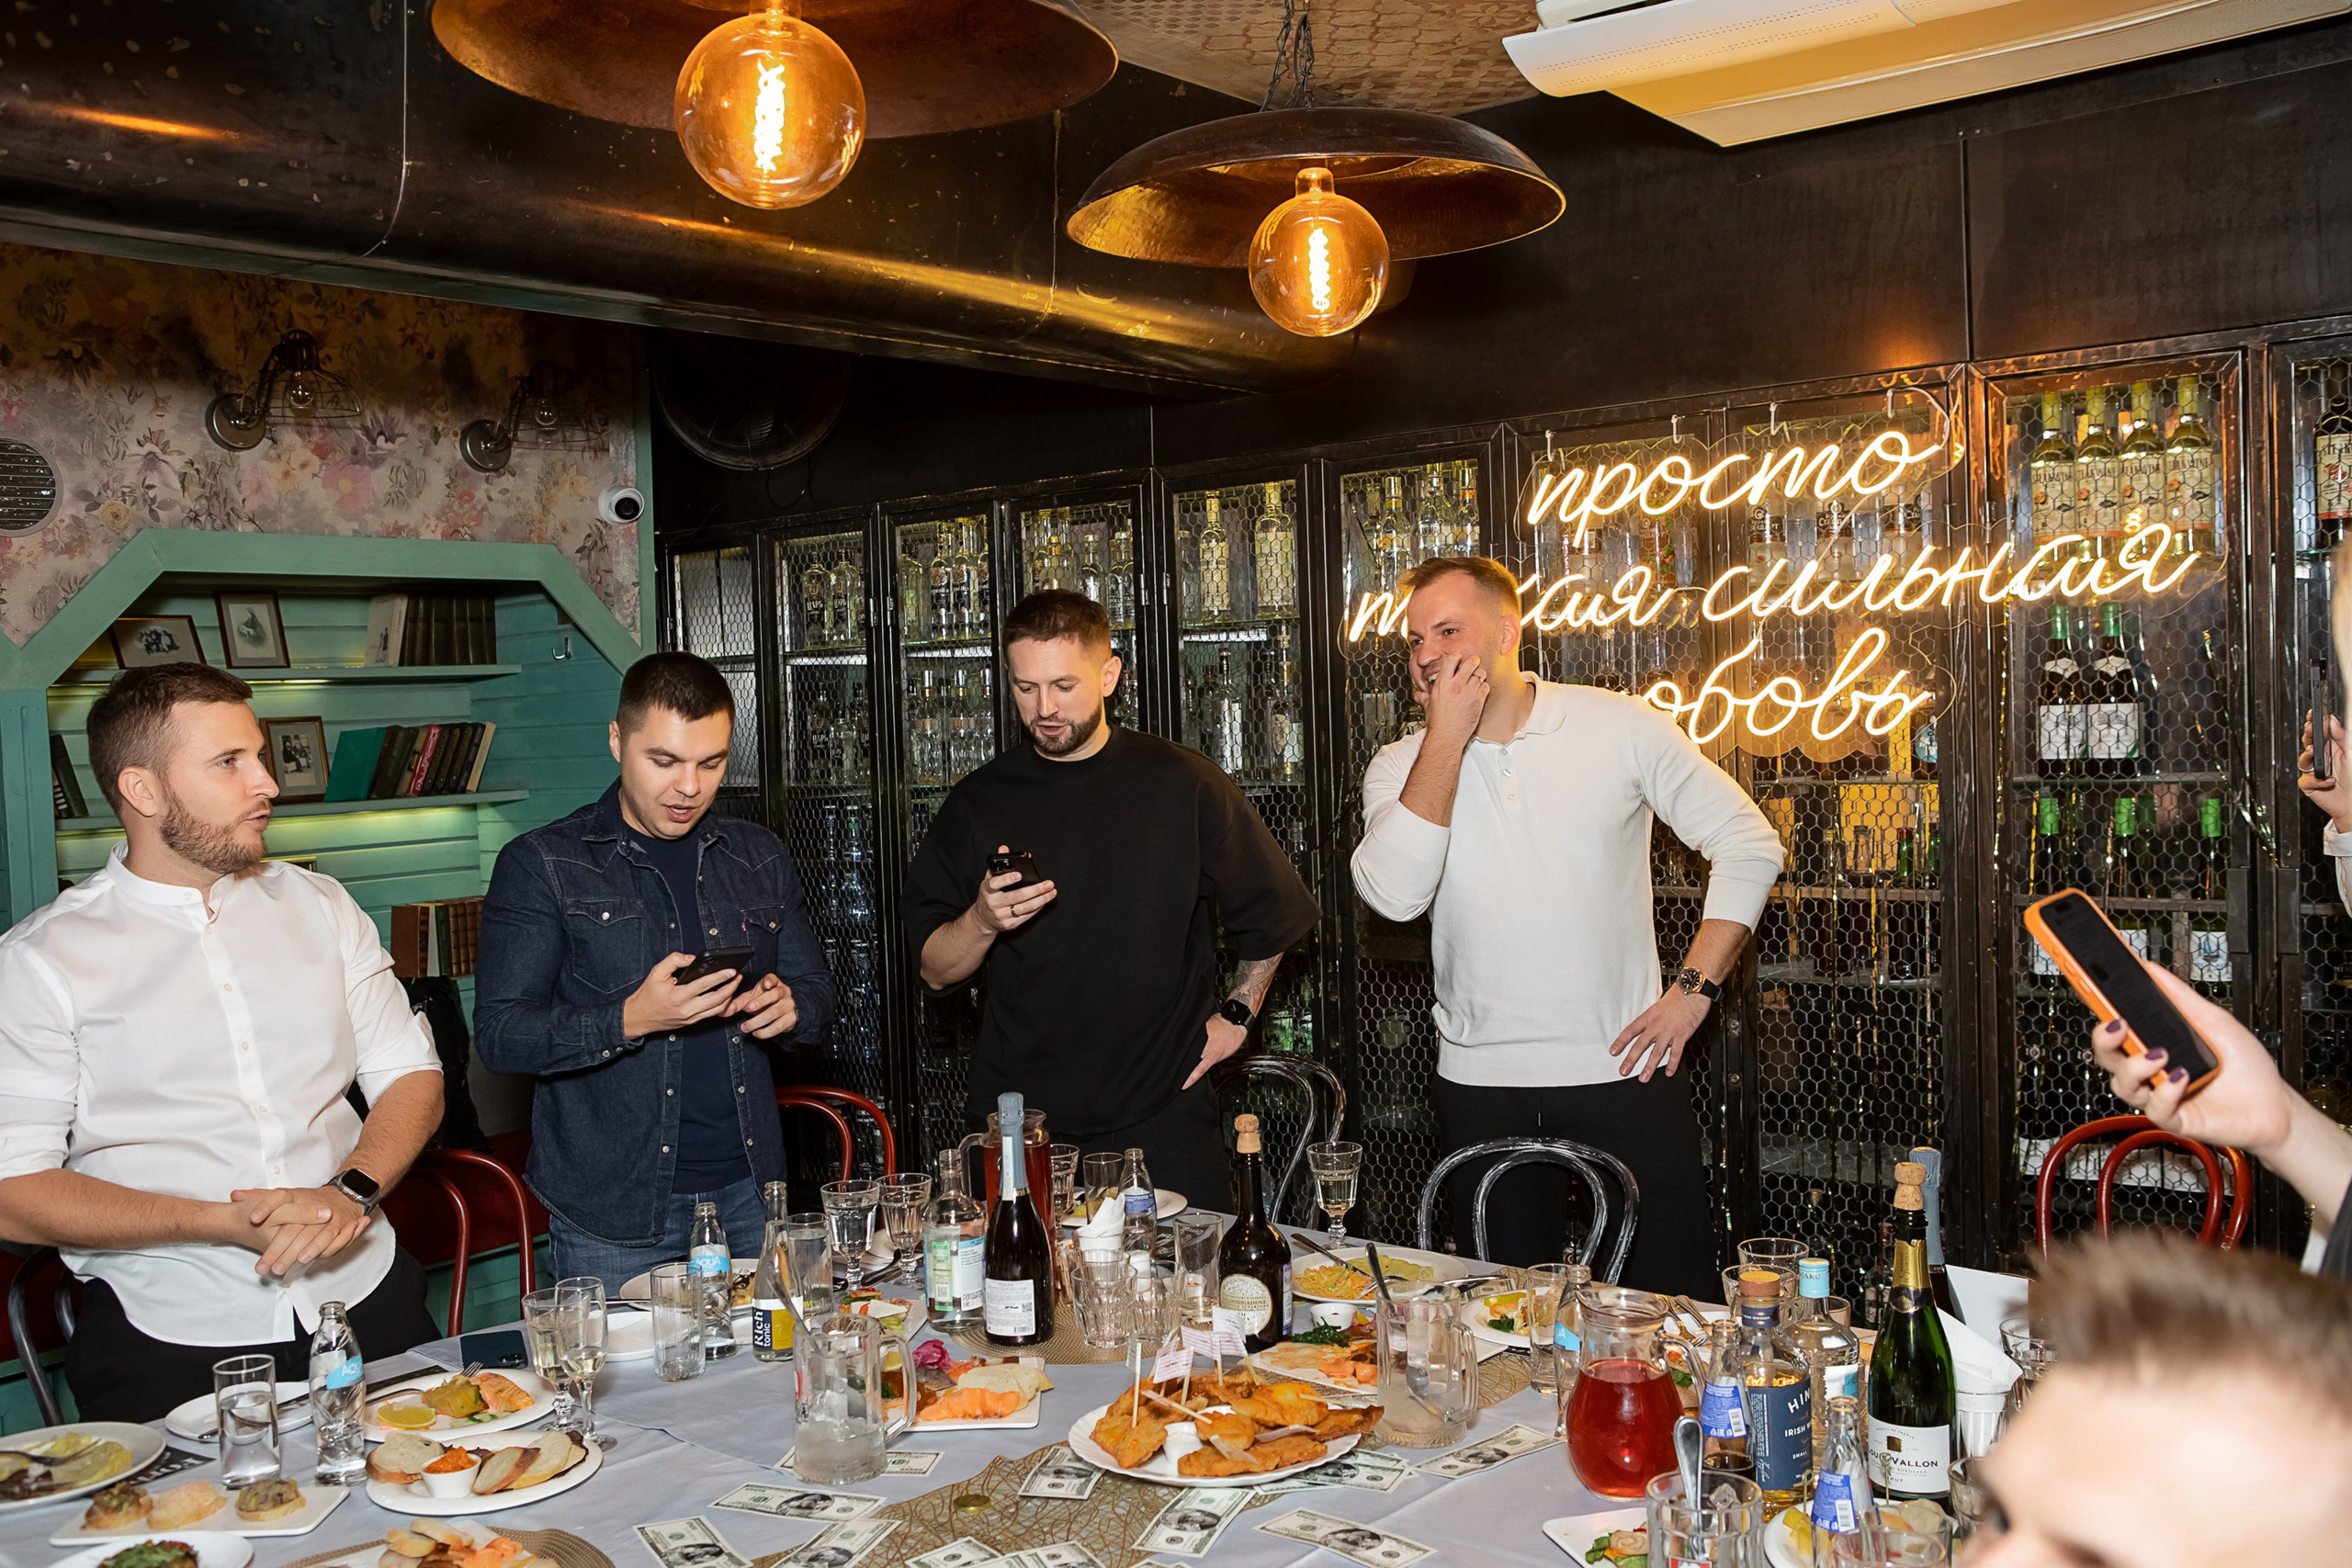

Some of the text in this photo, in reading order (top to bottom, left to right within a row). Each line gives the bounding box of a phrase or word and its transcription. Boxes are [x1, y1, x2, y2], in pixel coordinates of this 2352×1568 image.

[1526, 430, 1941, 549] просто
[1347, 522, 2199, 644] тая сильная
[695, 1256, 721, 1267] AQUA
[753, 1311, 763, 1347] Rich
[763, 1323, 771, 1348] tonic
[1784, 1425, 1805, 1438] IRISH
[1891, 1456, 1939, 1468] VALLON
